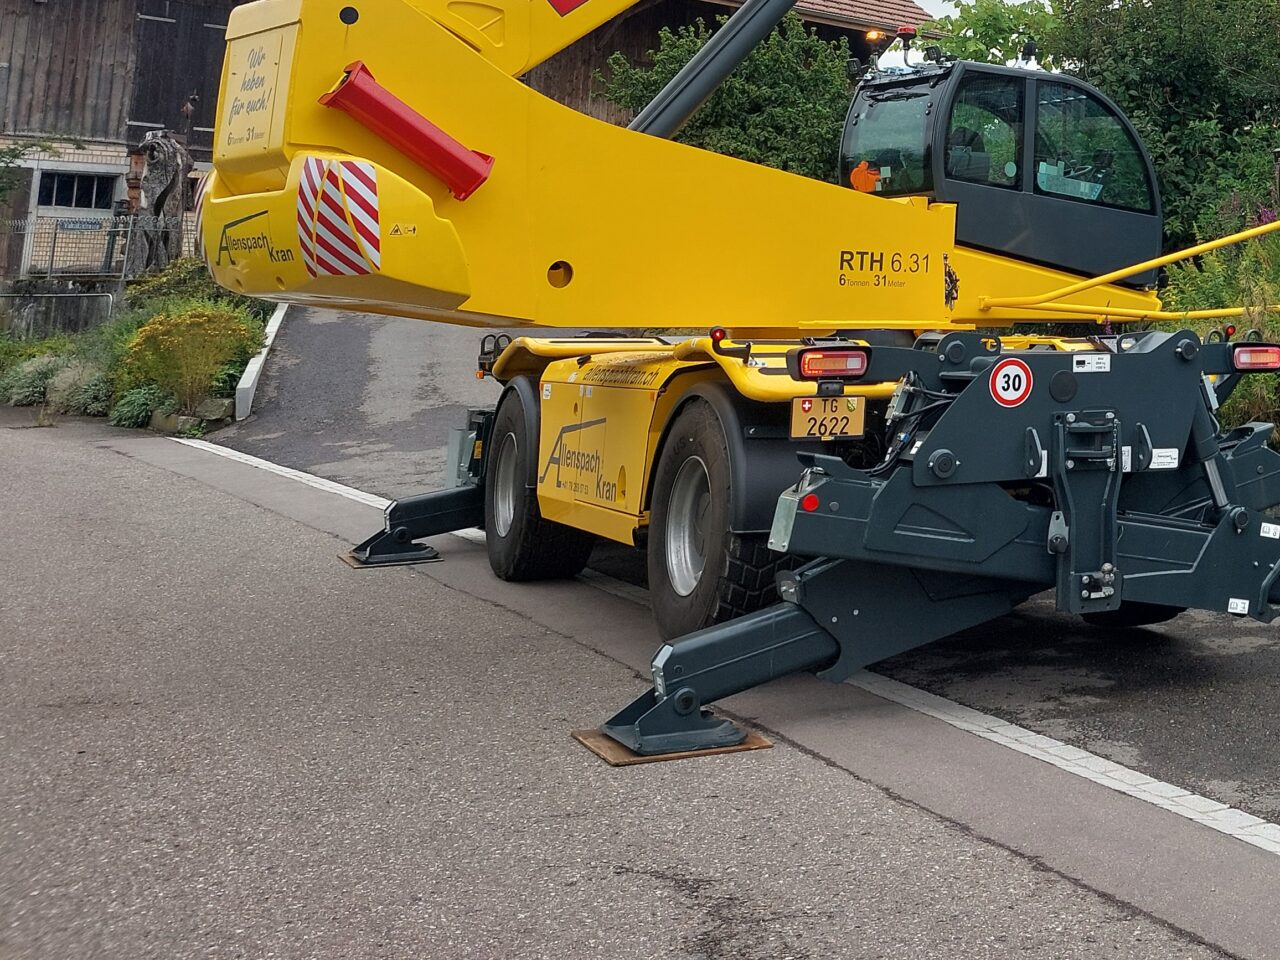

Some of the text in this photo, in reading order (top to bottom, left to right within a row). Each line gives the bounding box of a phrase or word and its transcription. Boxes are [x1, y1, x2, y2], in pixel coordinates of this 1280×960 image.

[247, 46, 266, 69] Wir
[240, 71, 265, 92] heben
[229, 87, 273, 127] für euch!
[215, 224, 269, 266] Allenspach
[268, 246, 295, 263] Kran
[840, 250, 929, 273] RTH 6.31
[1001, 373, 1022, 392] 30
[822, 398, 839, 413] TG
[807, 416, 850, 436] 2622
[539, 426, 601, 488] Allenspach
[595, 473, 618, 503] Kran
